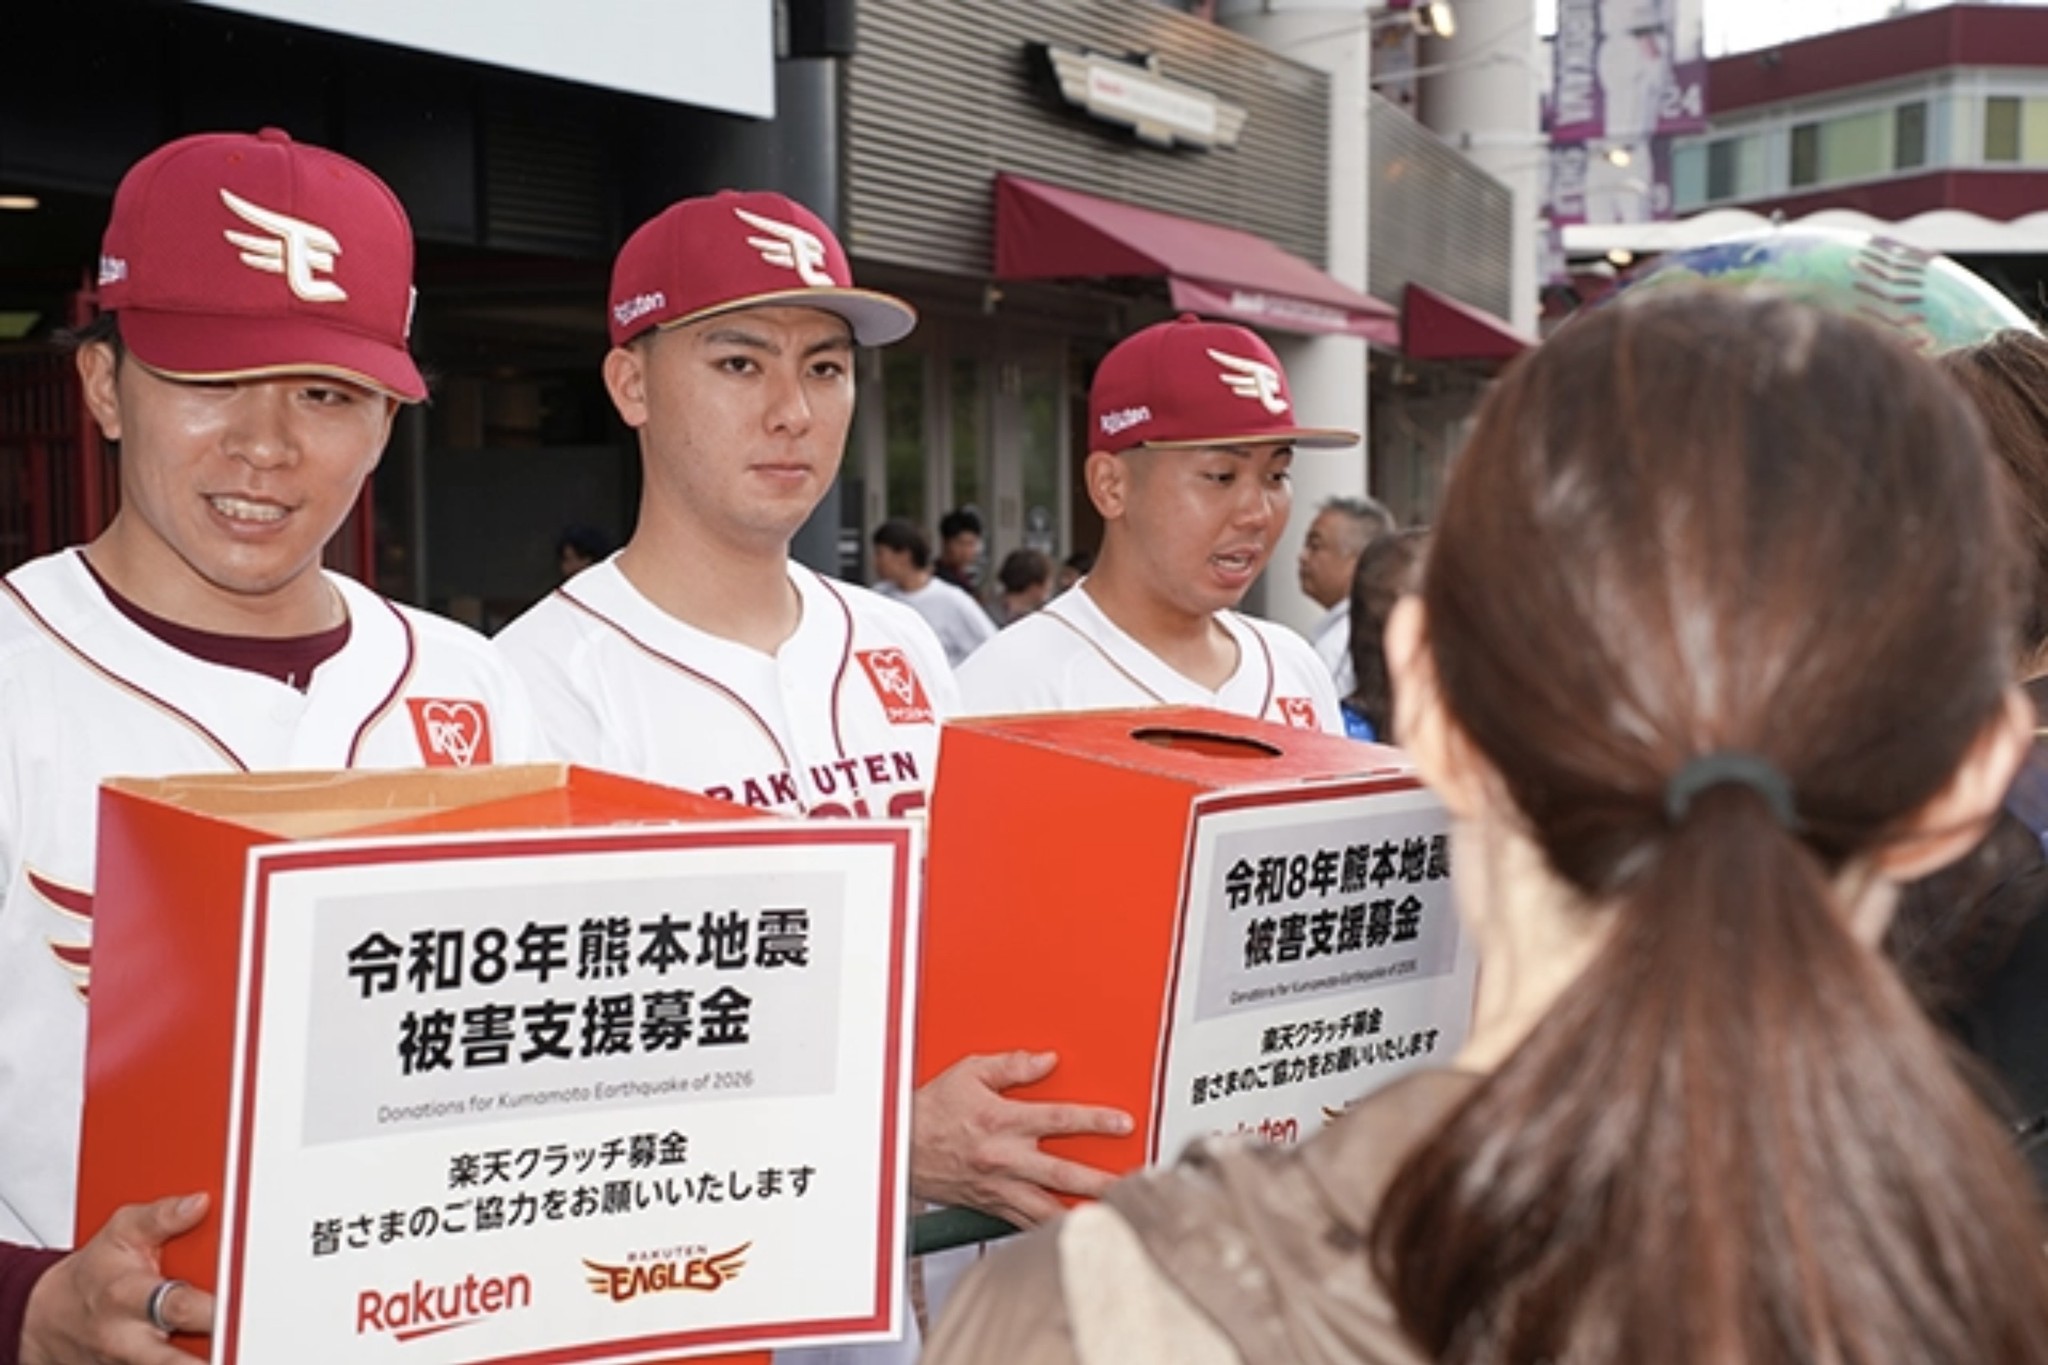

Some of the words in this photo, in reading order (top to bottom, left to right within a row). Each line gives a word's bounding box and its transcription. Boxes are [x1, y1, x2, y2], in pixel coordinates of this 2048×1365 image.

[1656, 83, 1702, 120] 24
[346, 907, 809, 999] 令和8年熊本地震
[1243, 894, 1423, 970] 被害支援募金
[397, 985, 753, 1076] 被害支援募金
[1262, 1007, 1383, 1054] 楽天クラッチ募金
[377, 1099, 465, 1123] Donations
[469, 1093, 494, 1113] for
[498, 1085, 591, 1109] Kumamoto
[594, 1077, 688, 1101] Earthquake
[692, 1072, 711, 1092] of
[713, 1069, 755, 1090] 2026
[1191, 1028, 1439, 1106] 皆さまのご協力をお願いいたします
[448, 1130, 689, 1190] 楽天クラッチ募金
[310, 1164, 816, 1258] 皆さまのご協力をお願いいたします
[587, 1243, 746, 1302] EAGLES
[626, 1243, 708, 1262] RAKUTEN
[355, 1271, 532, 1337] Rakuten
